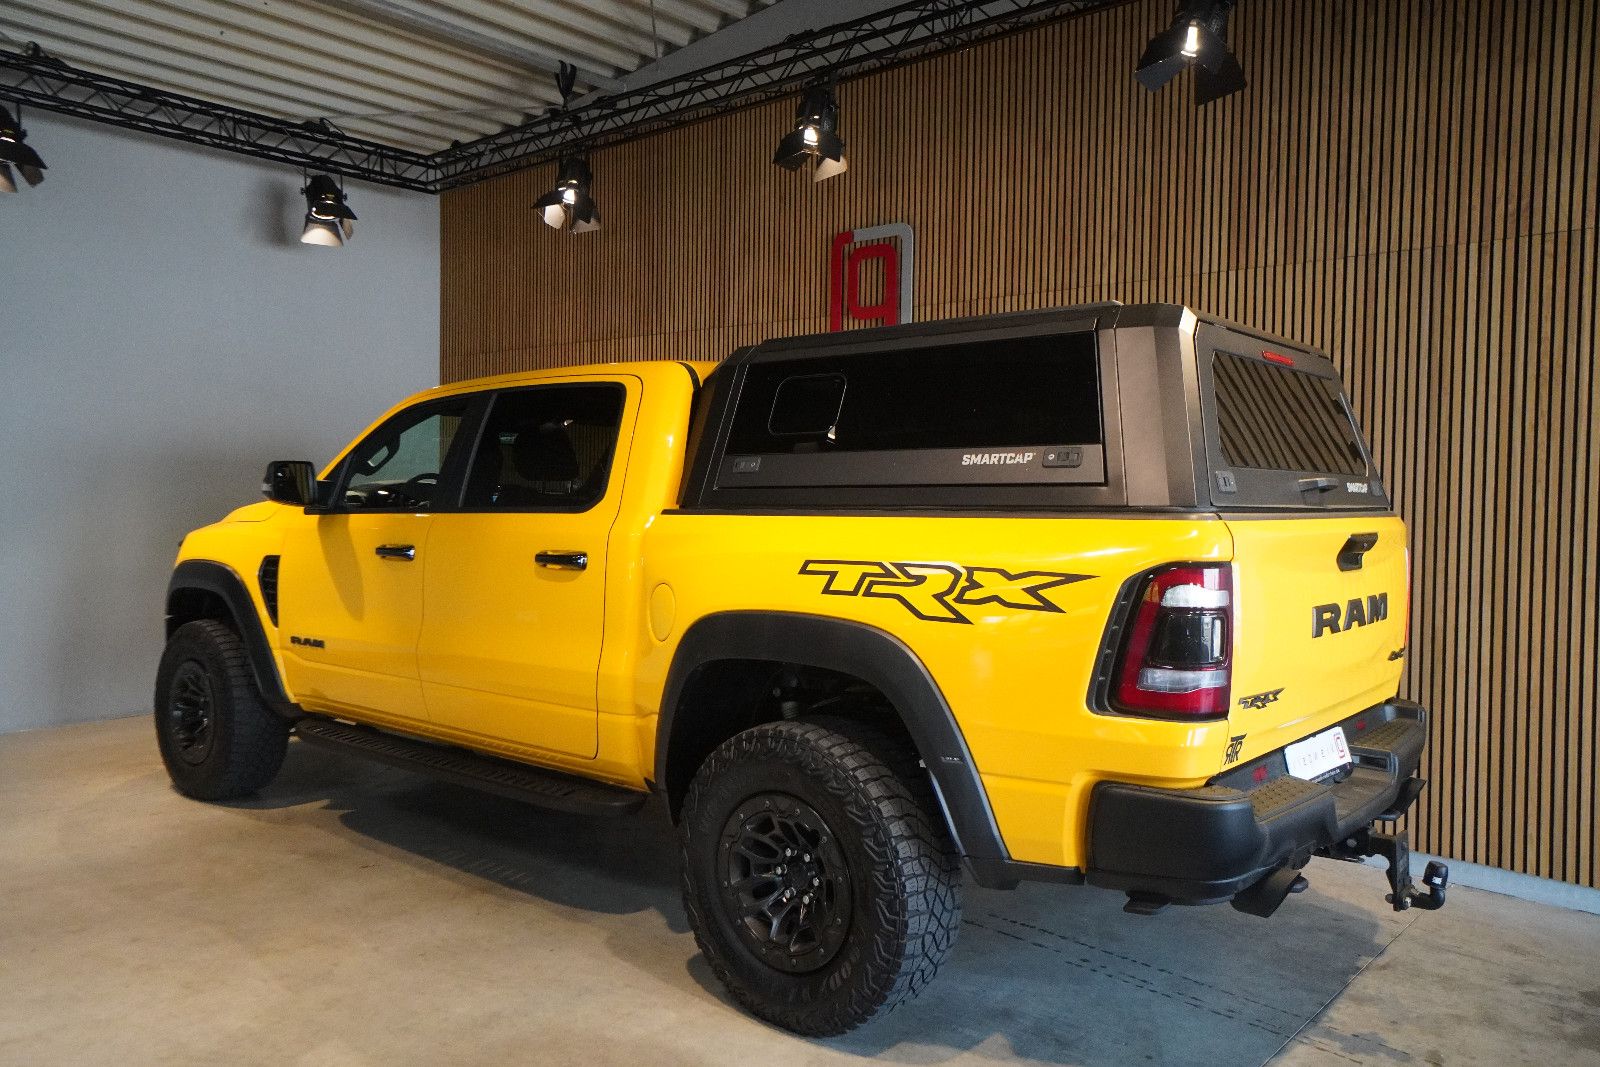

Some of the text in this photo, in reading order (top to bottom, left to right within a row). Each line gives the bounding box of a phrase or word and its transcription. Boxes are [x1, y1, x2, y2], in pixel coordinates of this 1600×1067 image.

[961, 452, 1034, 466] SMARTCAP
[798, 559, 1101, 625] TRX
[1312, 592, 1388, 638] RAM
[290, 636, 325, 648] RAM
